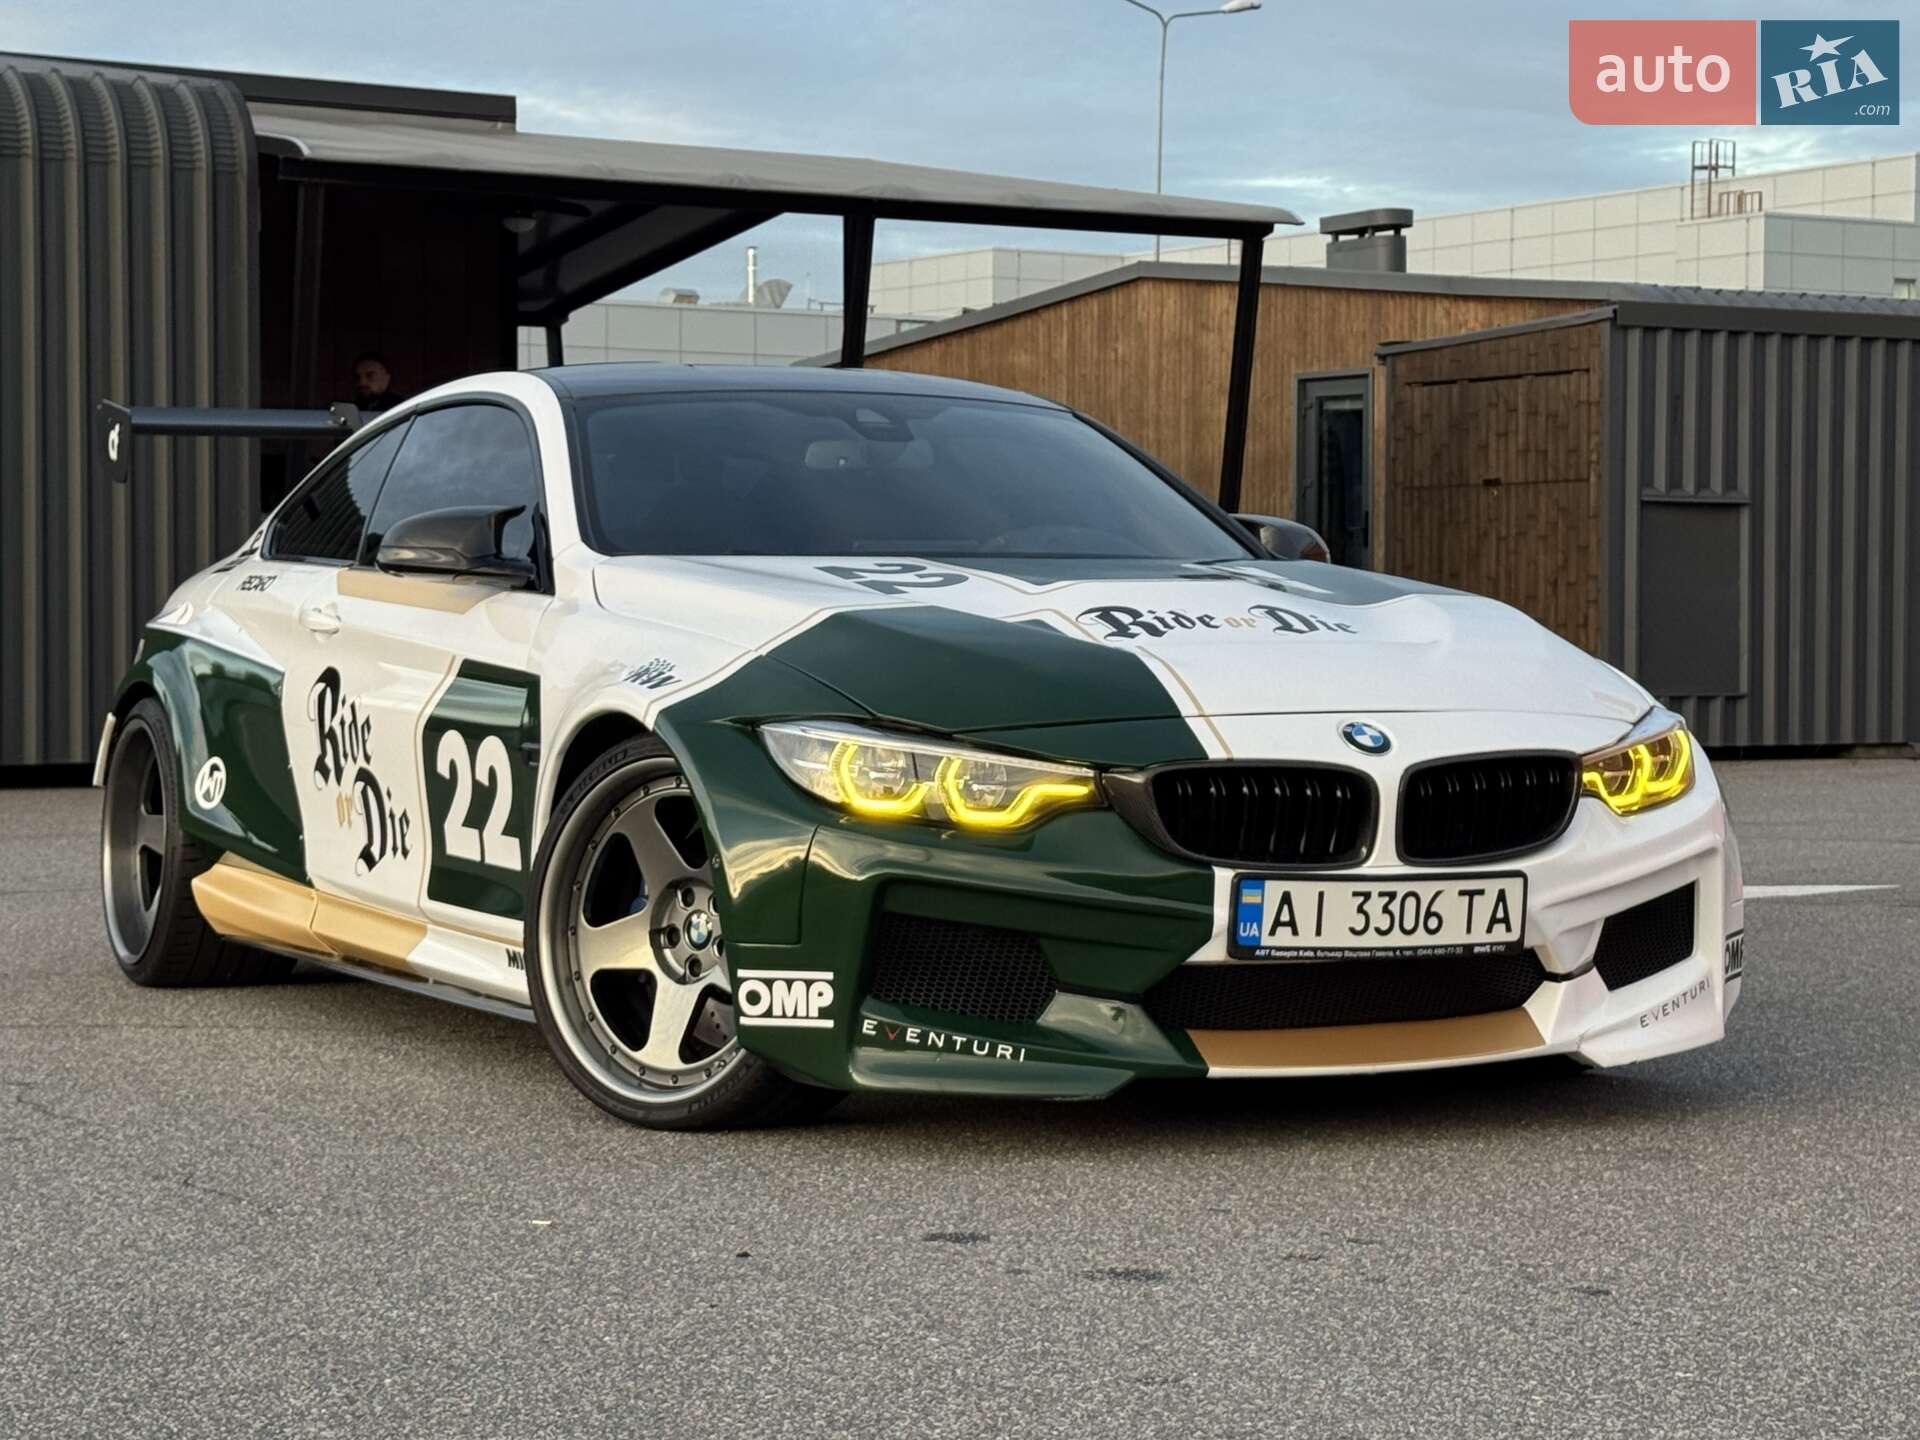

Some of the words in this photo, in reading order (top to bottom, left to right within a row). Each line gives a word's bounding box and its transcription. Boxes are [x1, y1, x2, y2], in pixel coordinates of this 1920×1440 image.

[1075, 604, 1222, 642] Ride
[1247, 604, 1358, 635] Die
[307, 666, 372, 791] Ride
[352, 766, 412, 877] Die
[436, 729, 522, 871] 22
[1239, 922, 1259, 937] UA
[1268, 890, 1325, 937] AI
[1348, 889, 1444, 936] 3306
[1458, 888, 1512, 934] TA
[737, 978, 834, 1018] OMP
[1640, 976, 1710, 1028] EVENTURI
[862, 1019, 1026, 1062] EVENTURI
